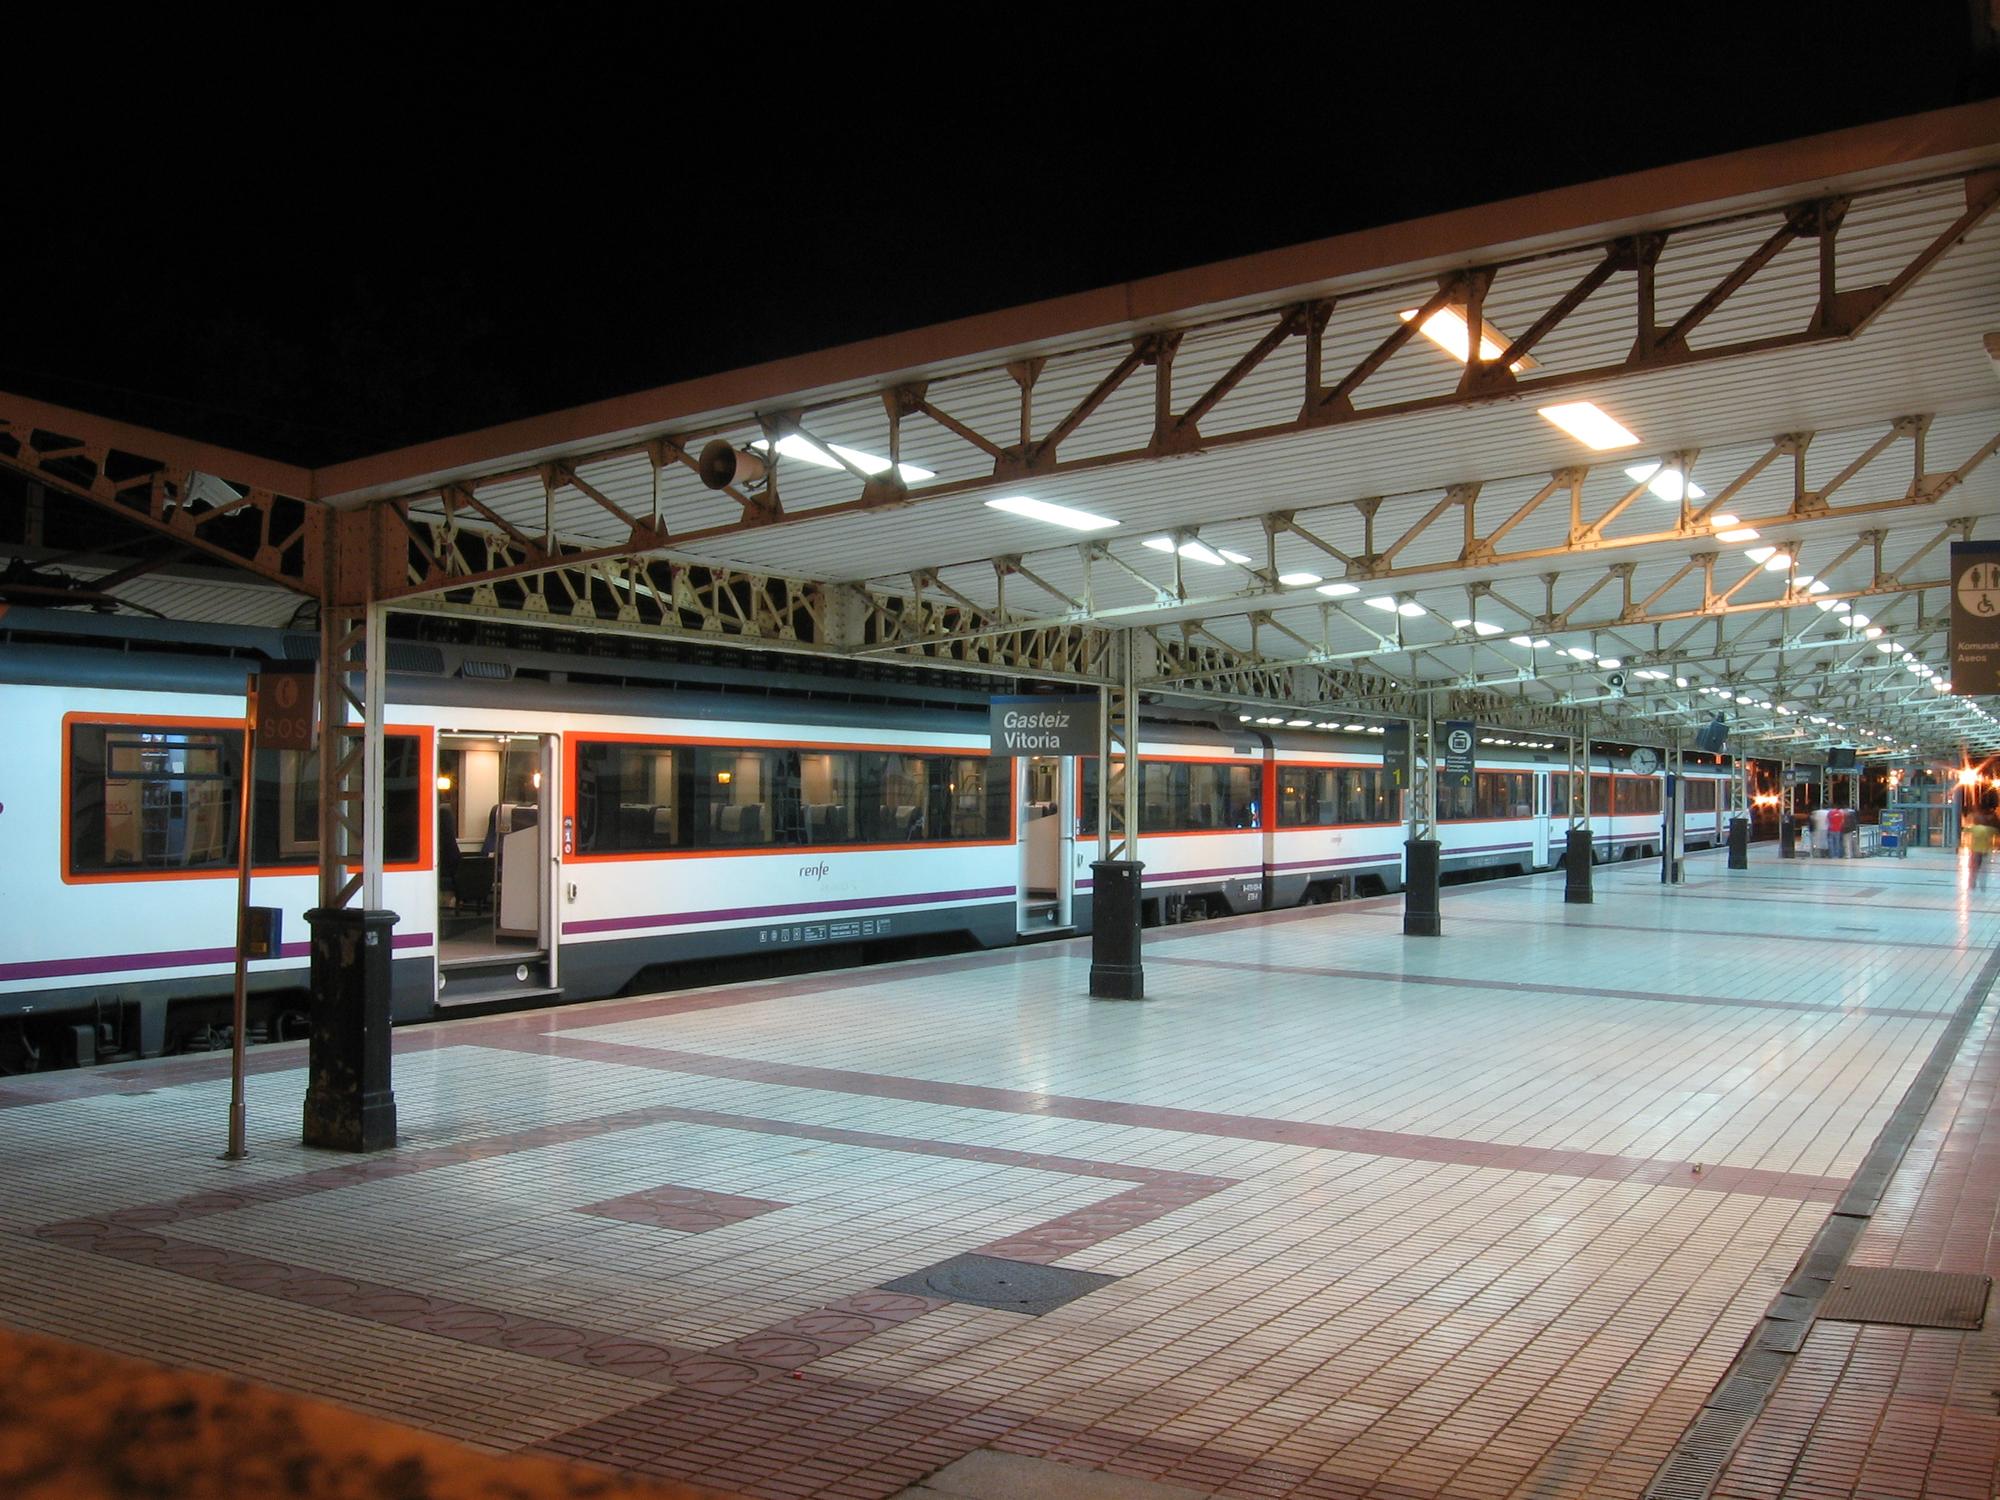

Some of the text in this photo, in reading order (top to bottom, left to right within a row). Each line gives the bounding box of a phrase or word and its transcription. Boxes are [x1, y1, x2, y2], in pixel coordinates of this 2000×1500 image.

[1958, 654, 1987, 662] Aseos
[264, 718, 307, 738] SOS
[1003, 710, 1070, 729] Gasteiz
[1004, 731, 1061, 749] Vitoria
[1391, 767, 1401, 785] 1
[799, 860, 830, 882] renfe
